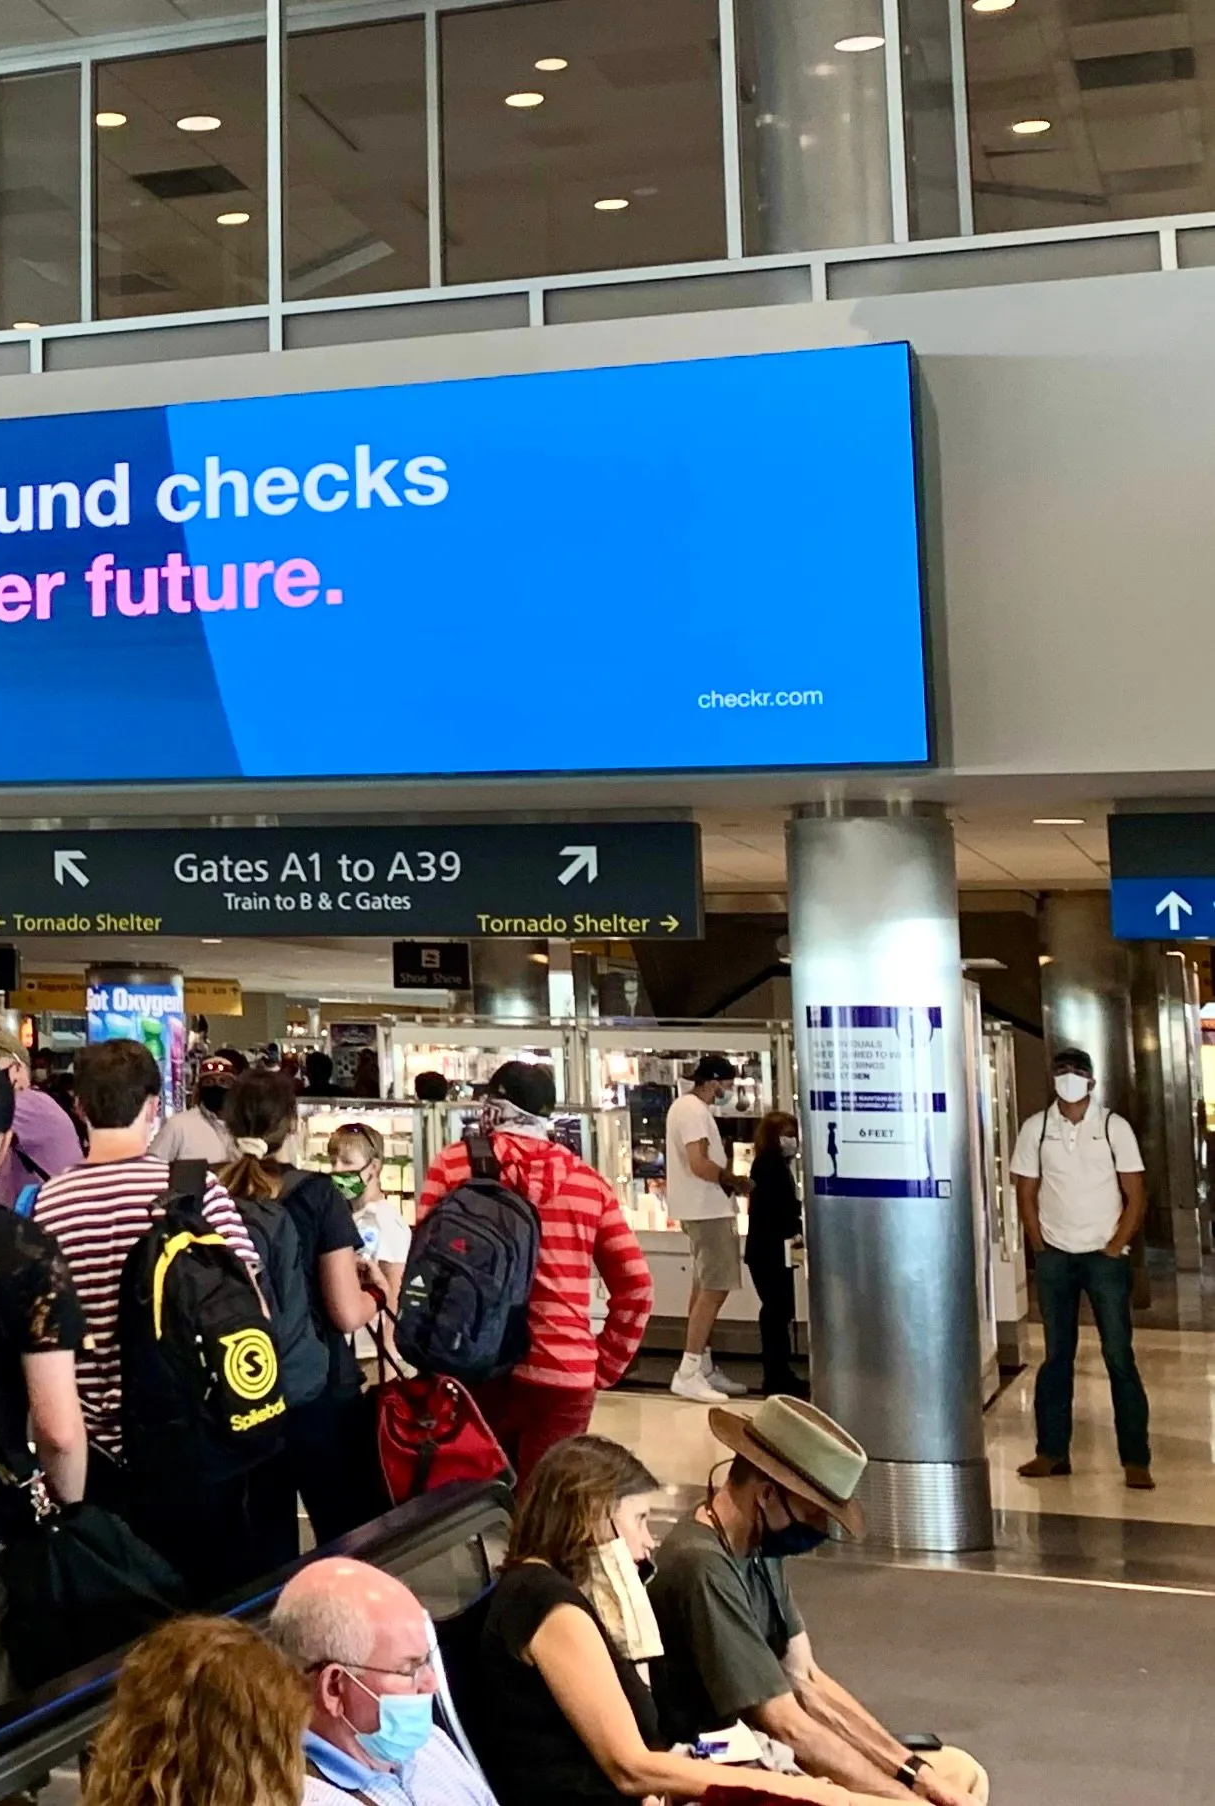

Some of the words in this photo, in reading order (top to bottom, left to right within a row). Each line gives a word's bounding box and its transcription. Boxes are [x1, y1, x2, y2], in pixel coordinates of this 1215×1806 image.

[156, 444, 449, 524] checks
[84, 550, 344, 617] future.
[697, 688, 824, 709] checkr.com
[173, 853, 270, 883] Gates
[280, 852, 322, 882] A1
[337, 853, 376, 883] to
[387, 850, 462, 882] A39
[223, 891, 270, 911] Train
[274, 894, 296, 911] to
[300, 892, 313, 910] B
[318, 892, 333, 911] &
[337, 892, 352, 911] C
[355, 892, 412, 911] Gates
[12, 913, 91, 932] Tornado
[95, 913, 163, 932] Shelter
[476, 913, 568, 933] Tornado
[573, 913, 650, 933] Shelter
[399, 972, 428, 984] Shoe
[432, 972, 463, 985] Shine
[112, 986, 184, 1017] Oxygen
[859, 1127, 867, 1138] 6
[868, 1129, 895, 1138] FEET
